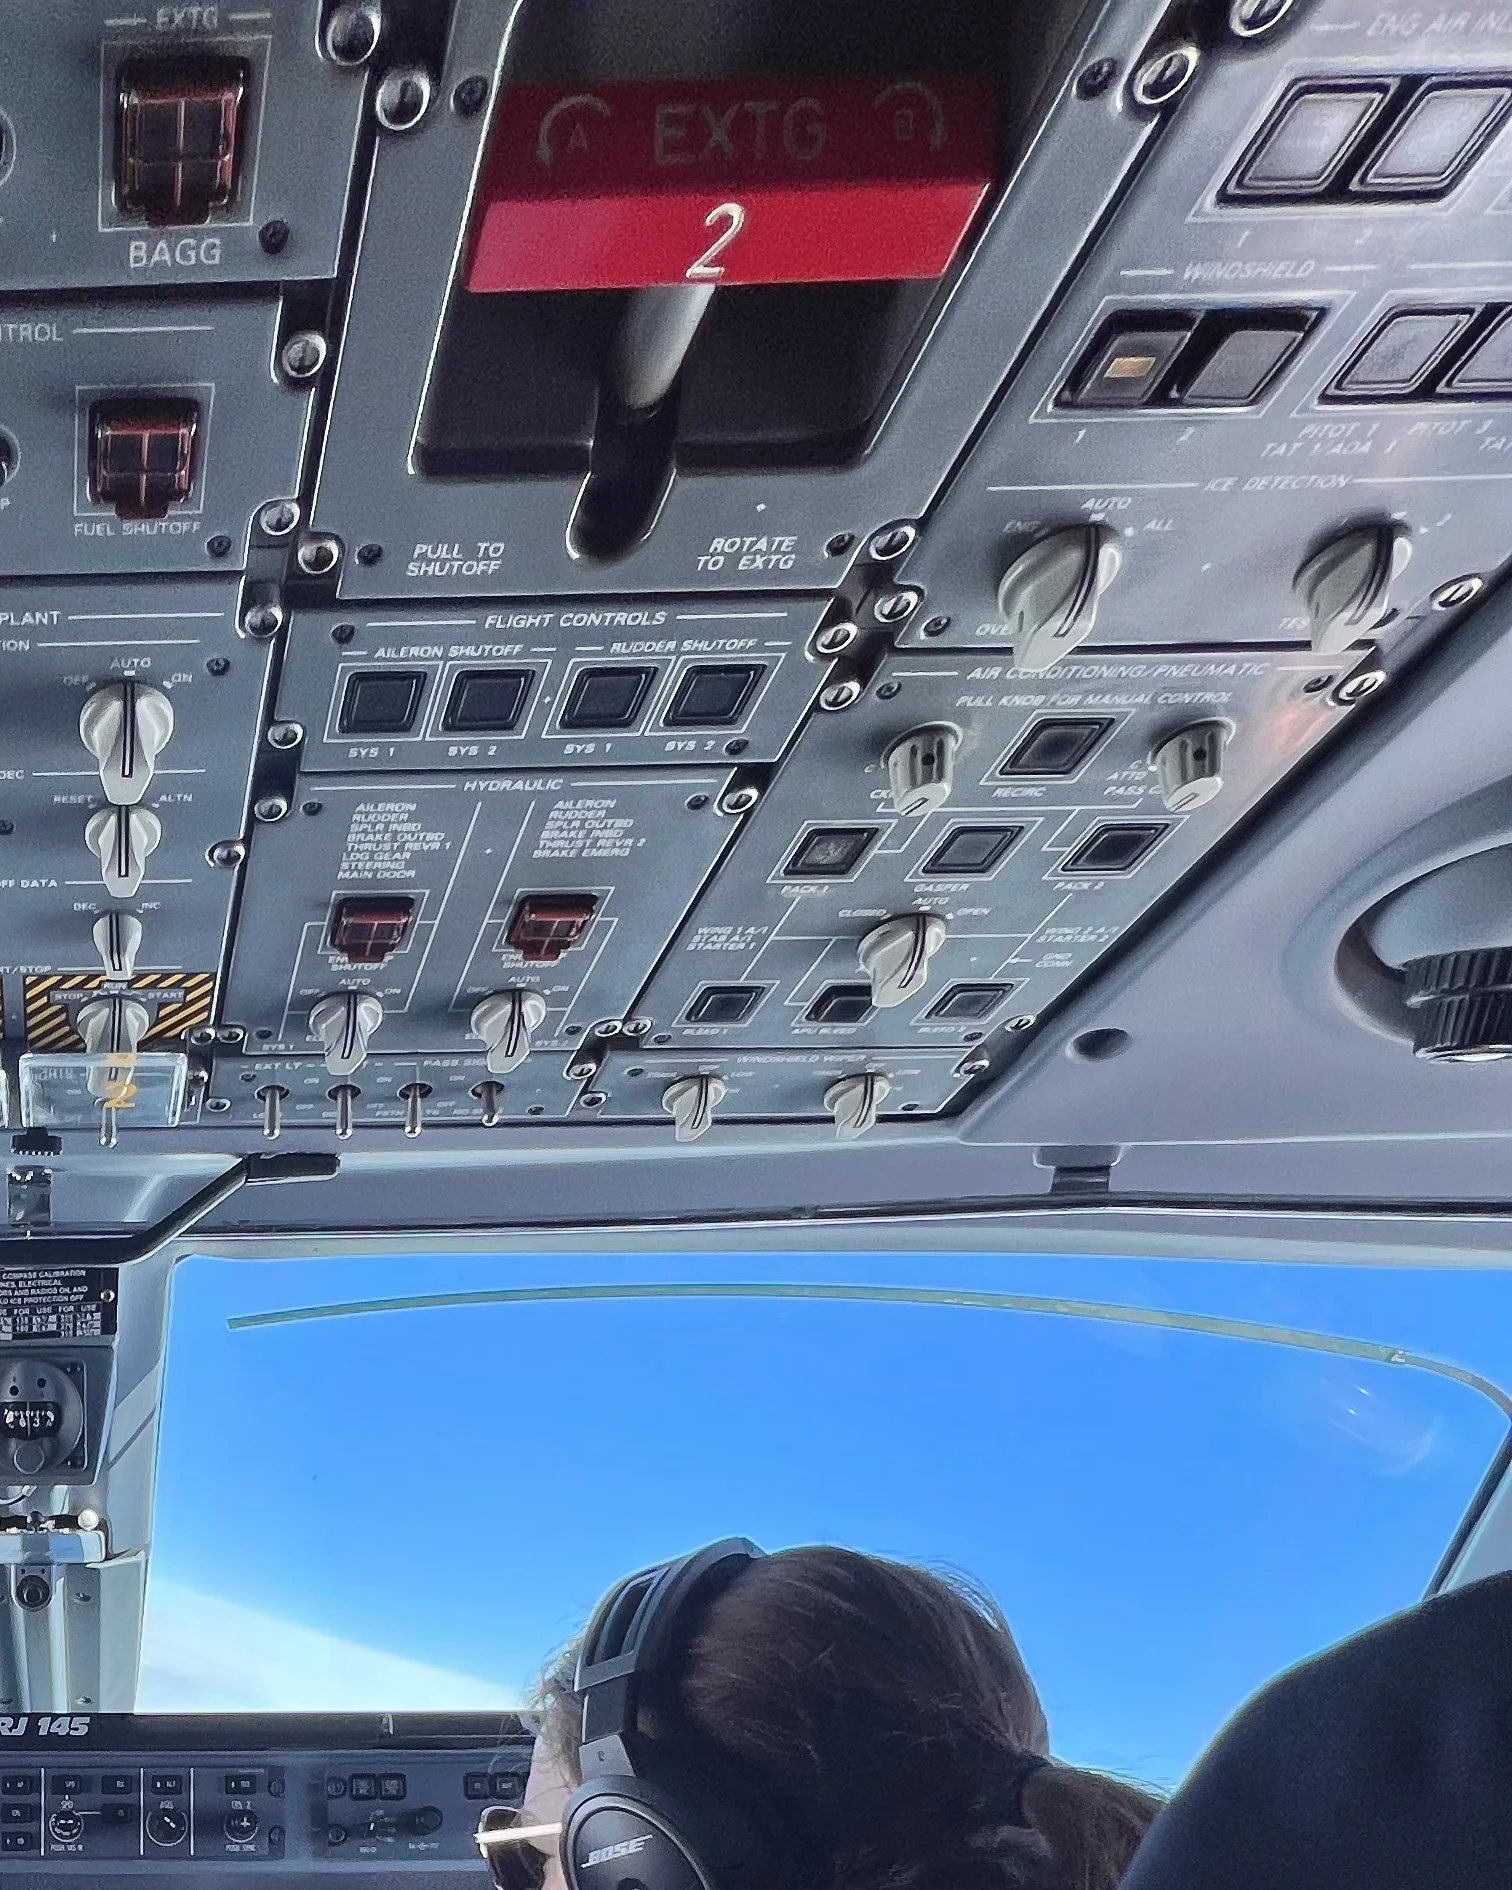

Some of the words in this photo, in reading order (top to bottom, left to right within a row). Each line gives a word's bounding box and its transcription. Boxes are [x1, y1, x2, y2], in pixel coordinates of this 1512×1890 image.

[155, 7, 220, 31] EXTG
[654, 98, 826, 166] EXTG
[685, 202, 746, 280] 2
[128, 239, 222, 268] BAGG
[1182, 259, 1316, 280] WINDSHIELD
[1296, 421, 1361, 440] PITOT
[1406, 419, 1472, 437] PITOT
[1205, 476, 1239, 492] ICE
[1241, 474, 1356, 492] DETECTION
[1081, 497, 1133, 512] AUTO
[73, 522, 117, 537] FUEL
[121, 520, 203, 536] SHUTOFF
[1143, 518, 1178, 532] ALL
[412, 543, 469, 558] PULL
[475, 541, 505, 558] TO
[708, 536, 797, 553] ROTATE
[696, 553, 724, 570] TO
[736, 553, 796, 570] EXTG
[405, 559, 503, 577] SHUTOFF
[484, 612, 555, 629] FLIGHT
[559, 611, 667, 627] CONTROLS
[373, 644, 445, 659] AILERON
[449, 642, 524, 657] SHUTOFF
[609, 640, 677, 654] RUDDER
[681, 637, 759, 652] SHUTOFF
[110, 657, 153, 670] AUTO
[171, 673, 194, 686] ON
[966, 667, 1001, 681] AIR
[956, 694, 999, 708] PULL
[999, 694, 1043, 707] KNOB
[1047, 693, 1082, 706] FOR
[1083, 691, 1155, 706] MANUAL
[1156, 690, 1235, 705] CONTROL
[447, 745, 481, 756] SYS
[488, 745, 498, 755] 2
[564, 743, 597, 753] SYS
[604, 742, 613, 753] 1
[664, 741, 698, 752] SYS
[705, 739, 716, 751] 2
[348, 747, 381, 758] SYS
[388, 747, 396, 758] 1
[463, 778, 564, 792] HYDRAULIC
[158, 792, 194, 804] ALTN
[990, 786, 1048, 799] RECIRC
[355, 802, 417, 812] AILERON
[553, 799, 617, 809] AILERON
[352, 813, 409, 822] RUDDER
[550, 809, 607, 819] RUDDER
[346, 832, 392, 842] BRAKE
[541, 829, 586, 839] BRAKE
[345, 841, 404, 852] THRUST
[406, 841, 443, 851] REVR
[538, 838, 595, 849] THRUST
[598, 838, 634, 848] REVR
[342, 851, 371, 861] LDG
[375, 851, 411, 861] GEAR
[532, 848, 579, 859] BRAKE
[582, 847, 631, 858] EMERG
[340, 860, 407, 870] STEERING
[337, 870, 373, 880] MAIN
[376, 869, 416, 880] DOOR
[19, 878, 59, 890] DATA
[912, 882, 972, 893] GASPER
[912, 896, 949, 906] AUTO
[838, 908, 887, 919] CLOSED
[956, 907, 992, 918] OPEN
[339, 978, 372, 986] AUTO
[508, 975, 540, 984] AUTO
[102, 982, 127, 991] RUN
[385, 987, 402, 995] ON
[54, 993, 85, 1003] STOP
[147, 991, 184, 1001] START
[736, 1055, 820, 1064] WINDSHIELD
[822, 1054, 868, 1064] WIPER
[253, 1063, 281, 1071] EXT
[285, 1063, 302, 1071] LT
[2, 1272, 37, 1280] COMPASS
[23, 1295, 68, 1304] PROTECTION
[59, 1305, 75, 1313] FOR
[37, 1717, 91, 1736] 145
[581, 1834, 654, 1869] BOSE
